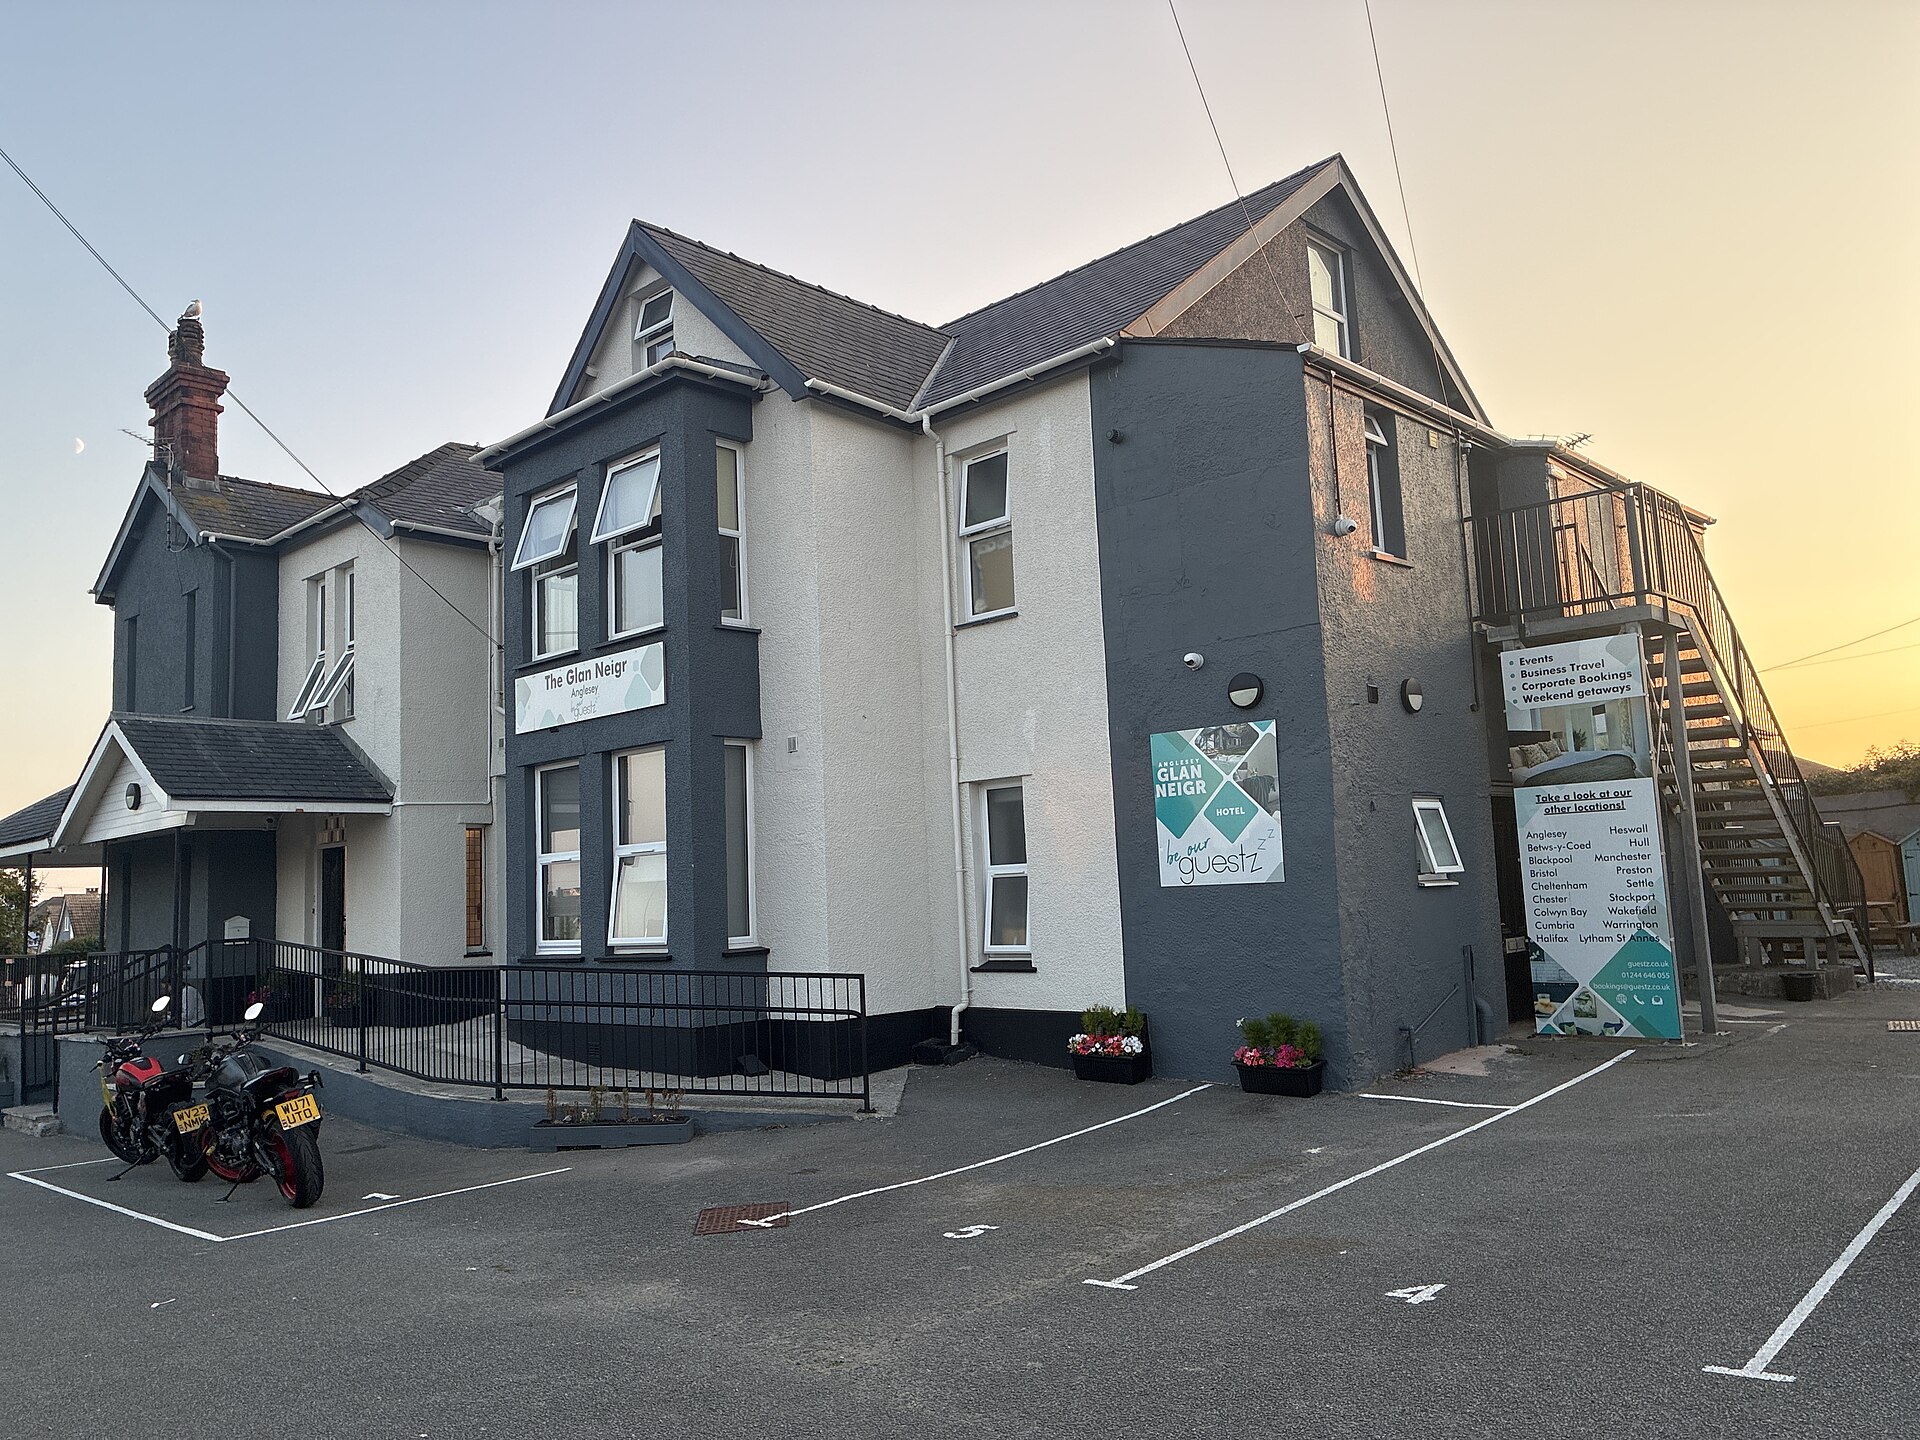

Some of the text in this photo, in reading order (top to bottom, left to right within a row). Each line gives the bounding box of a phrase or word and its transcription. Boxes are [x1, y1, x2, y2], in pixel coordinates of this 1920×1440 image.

[1519, 655, 1554, 666] Events
[1520, 659, 1604, 678] Business Travel
[544, 659, 628, 690] The Glan Neigr
[1522, 671, 1632, 691] Corporate Bookings
[570, 685, 598, 698] Anglesey
[1522, 684, 1631, 704] Weekend getaways
[1158, 758, 1200, 767] ANGLESEY
[1157, 764, 1202, 782] GLAN
[1156, 780, 1207, 798] NEIGR
[1536, 794, 1560, 803] Take
[1573, 790, 1595, 800] look
[1600, 790, 1610, 799] at
[1613, 789, 1631, 798] our
[1216, 806, 1246, 816] HOTEL
[1544, 800, 1625, 814] other locations!
[1609, 824, 1648, 835] Heswall
[1526, 830, 1568, 840] Anglesey
[1527, 841, 1592, 852] Betws-y-Coed
[1629, 838, 1650, 848] Hull
[1166, 838, 1211, 865] be our
[1528, 854, 1573, 866] Blackpool
[1594, 852, 1652, 862] Manchester
[1178, 844, 1262, 884] guestz
[1530, 869, 1558, 878] Bristol
[1616, 866, 1652, 875] Preston
[1531, 881, 1588, 891] Cheltenham
[1626, 879, 1654, 888] Settle
[1532, 895, 1568, 904] Chester
[1609, 892, 1656, 902] Stockport
[1534, 908, 1588, 918] Colwyn Bay
[1608, 906, 1657, 915] Wakefield
[1534, 921, 1575, 930] Cumbria
[1602, 920, 1659, 930] Warrington
[1536, 934, 1569, 943] Halifax
[1579, 934, 1660, 944] Lytham St Annes
[1628, 960, 1670, 968] guestz.co.uk
[1593, 982, 1670, 991] bookings@guestz.co.uk
[282, 1097, 310, 1114] WU71
[177, 1107, 207, 1122] WV23
[286, 1108, 312, 1124] UTO
[1384, 1284, 1448, 1304] 4
